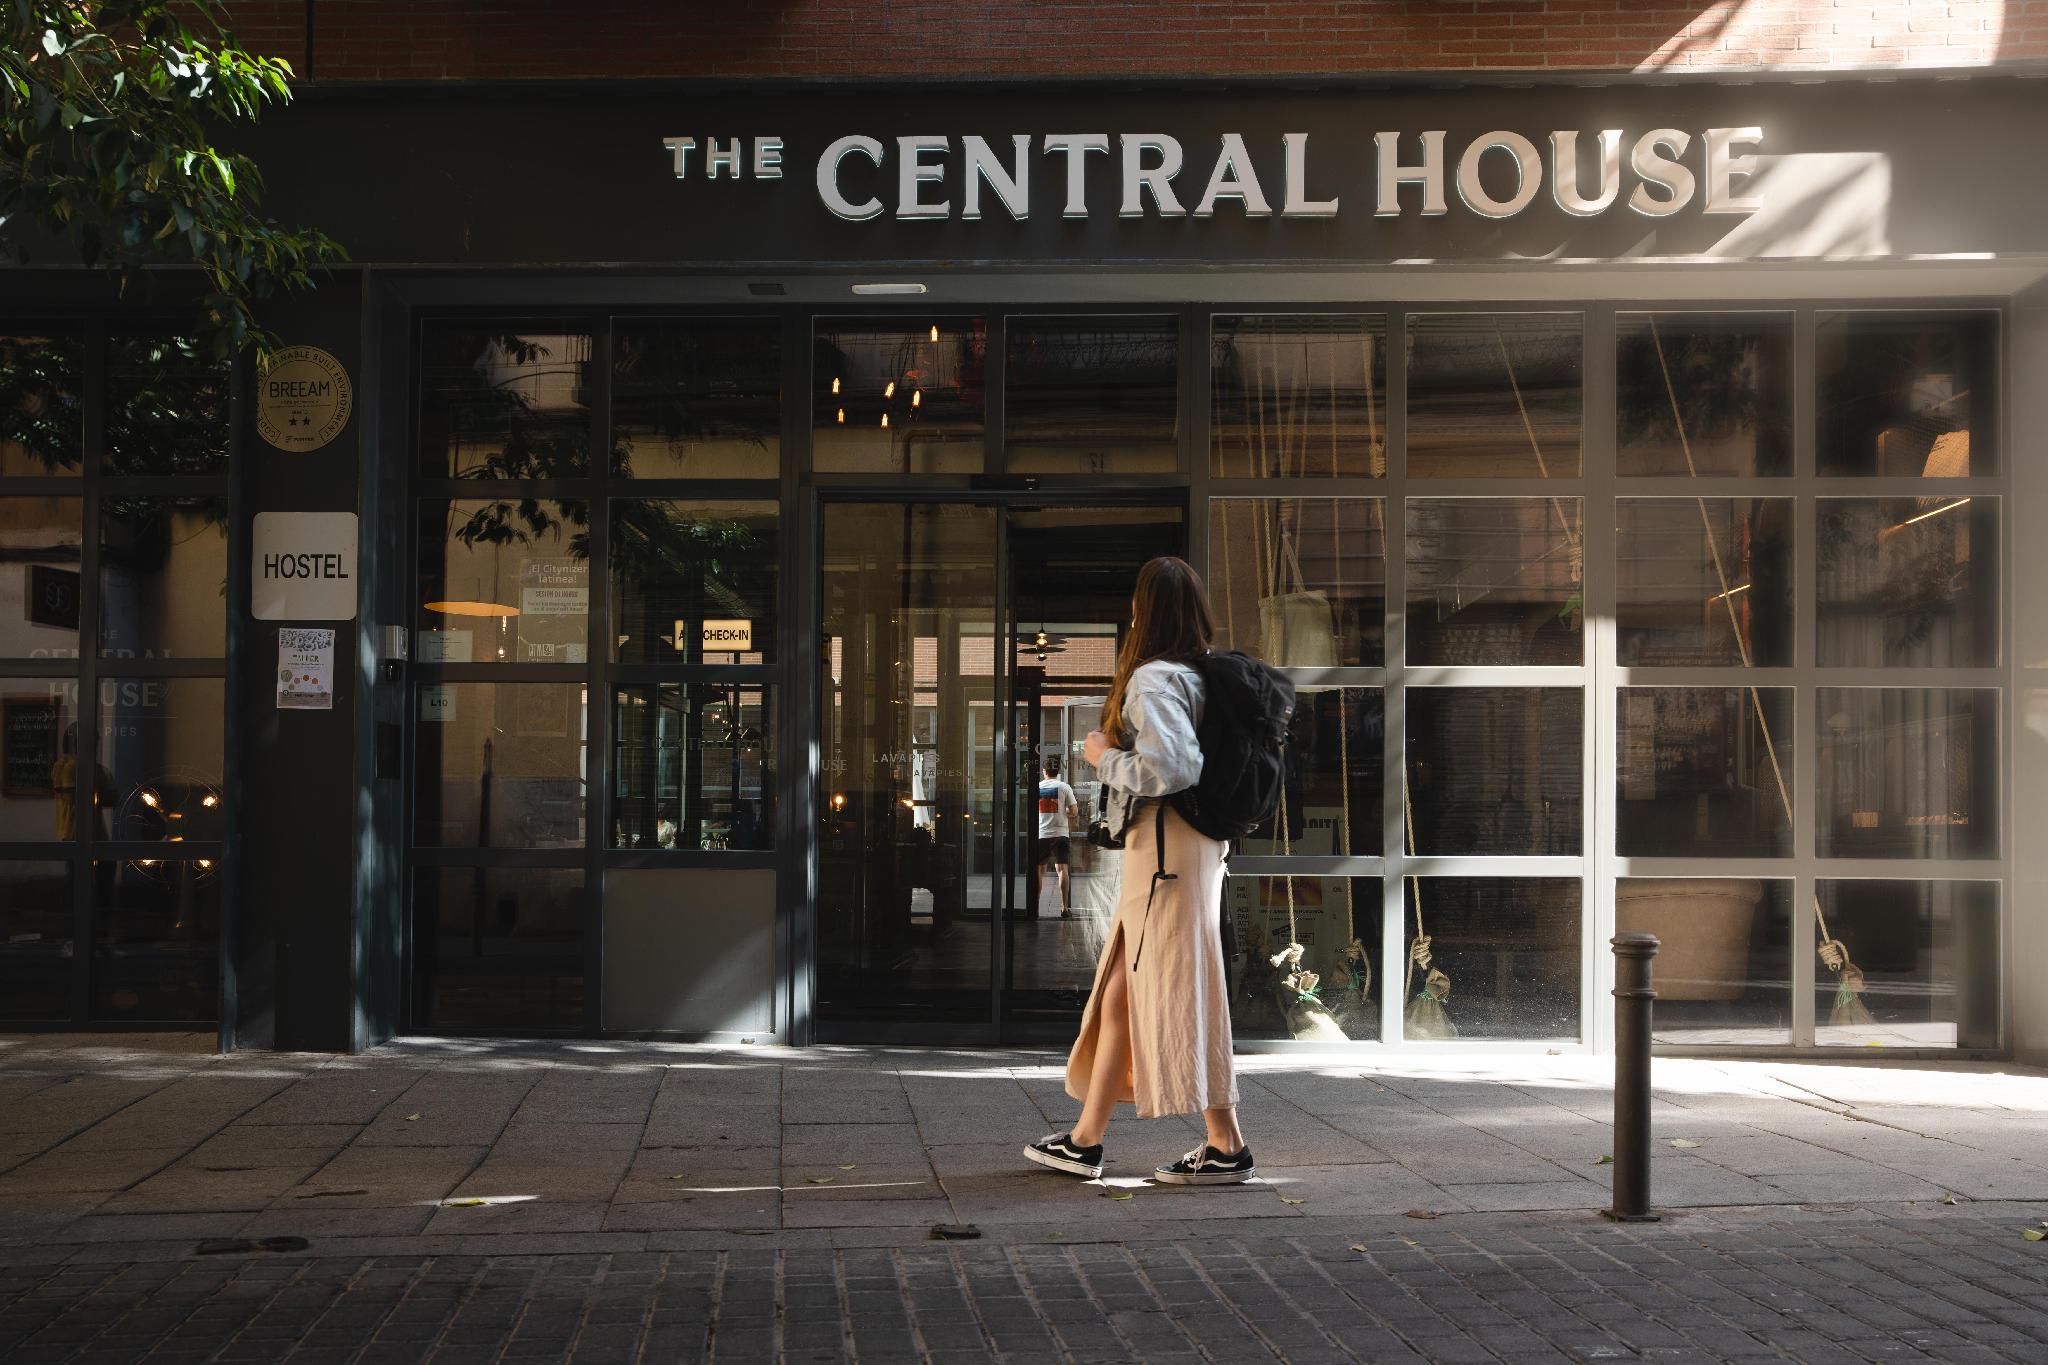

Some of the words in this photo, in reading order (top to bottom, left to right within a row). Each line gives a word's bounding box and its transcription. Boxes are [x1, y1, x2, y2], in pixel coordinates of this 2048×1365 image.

[662, 135, 784, 180] THE
[815, 132, 1339, 222] CENTRAL
[1373, 126, 1766, 219] HOUSE
[269, 380, 331, 398] BREEAM
[264, 553, 349, 579] HOSTEL
[703, 629, 749, 641] CHECK-IN
[49, 681, 160, 708] HUSE
